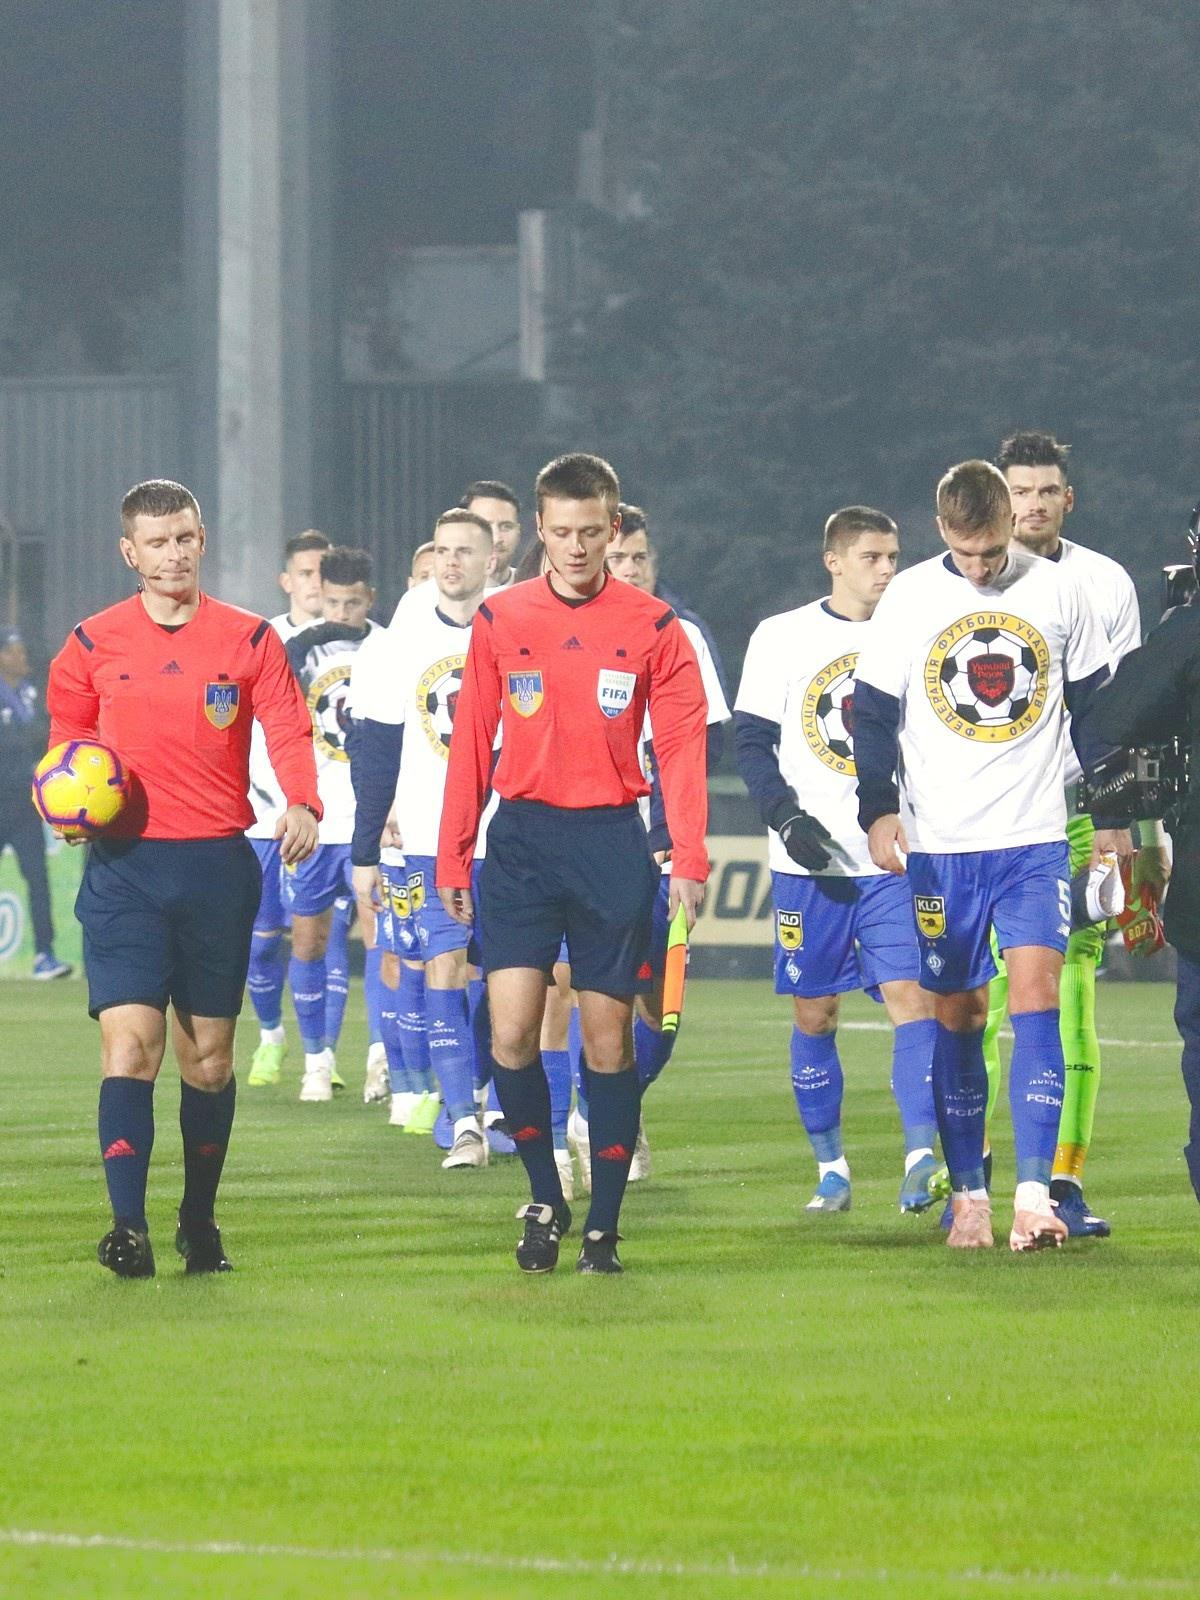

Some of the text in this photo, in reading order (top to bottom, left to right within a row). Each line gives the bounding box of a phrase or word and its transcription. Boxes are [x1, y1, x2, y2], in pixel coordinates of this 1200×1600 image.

[938, 614, 1008, 650] ФУТБОЛУ
[602, 687, 628, 700] FIFA
[928, 659, 976, 737] ФЕДЕРАЦІЯ
[804, 693, 846, 770] ФЕДЕРАЦІЯ
[1009, 713, 1033, 736] АТО
[918, 901, 941, 912] KLO
[1057, 879, 1071, 921] 5
[780, 914, 799, 926] KLO
[1026, 1093, 1063, 1108] FCDK
[946, 1105, 984, 1117] FCDK
